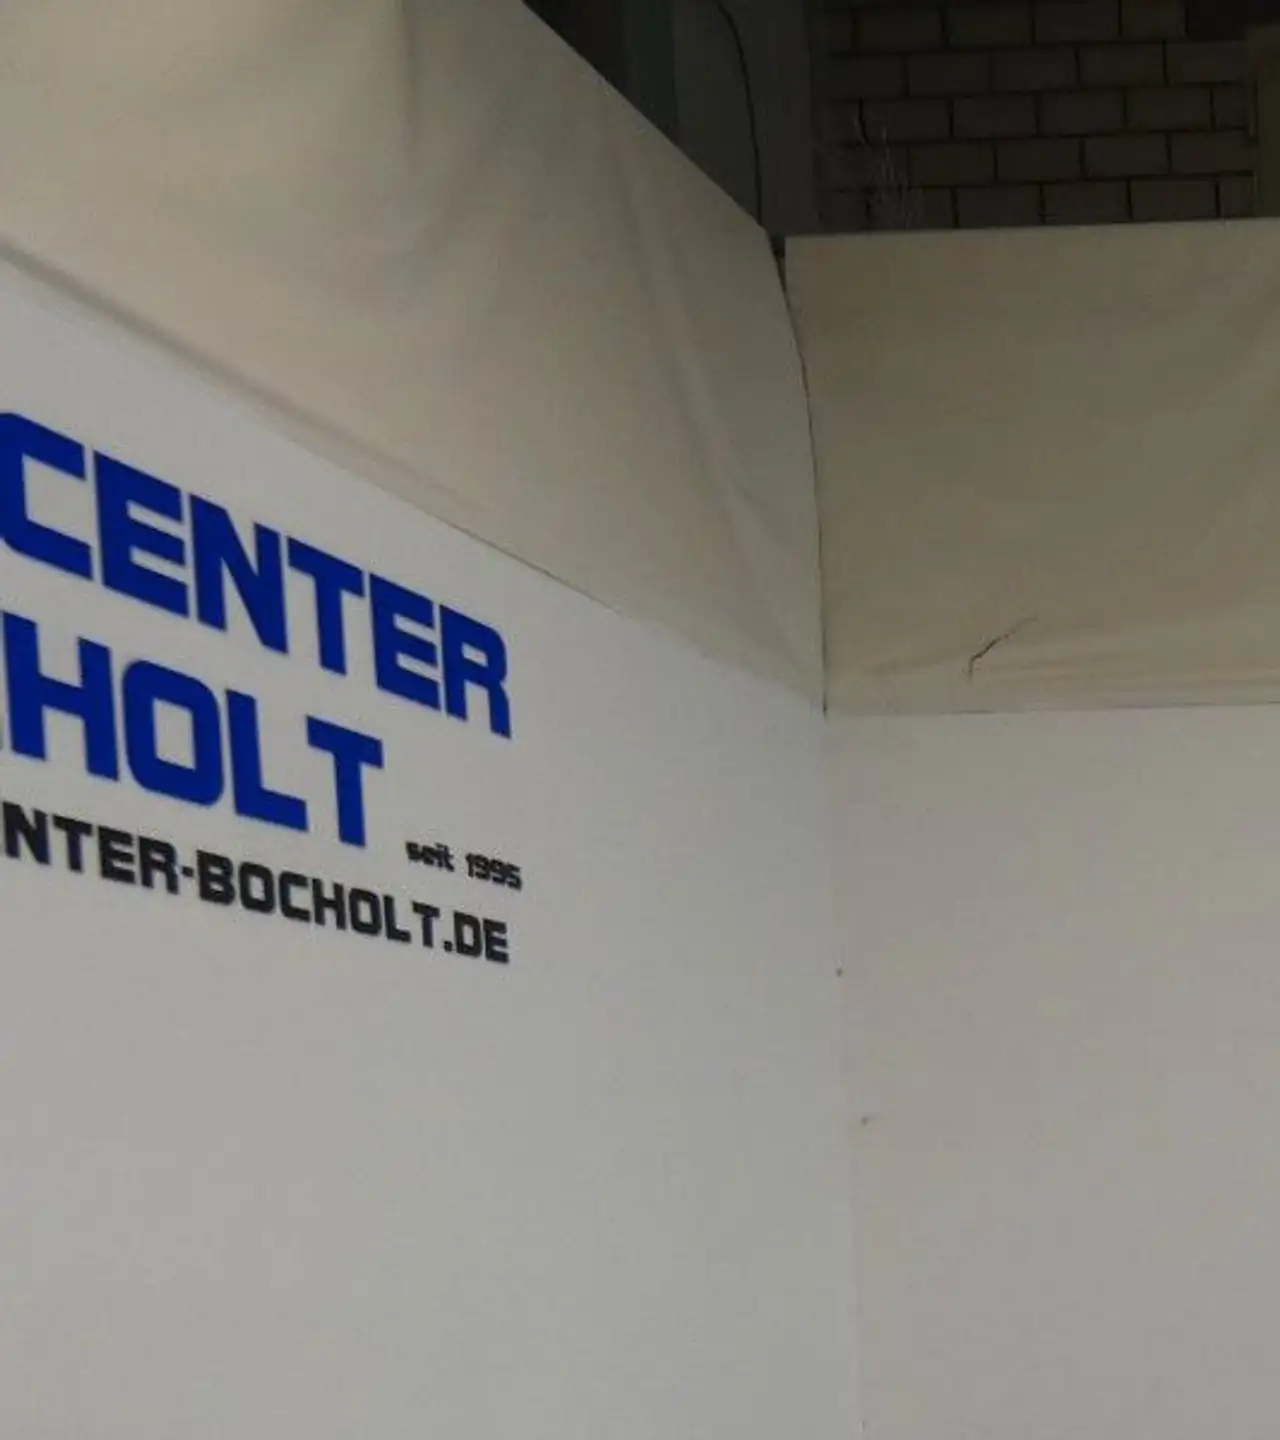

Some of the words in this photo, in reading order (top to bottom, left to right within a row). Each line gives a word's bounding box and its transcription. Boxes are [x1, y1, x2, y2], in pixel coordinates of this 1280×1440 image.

[0, 411, 513, 740] CENTER
[404, 840, 456, 874] seit
[464, 852, 524, 892] 1995
